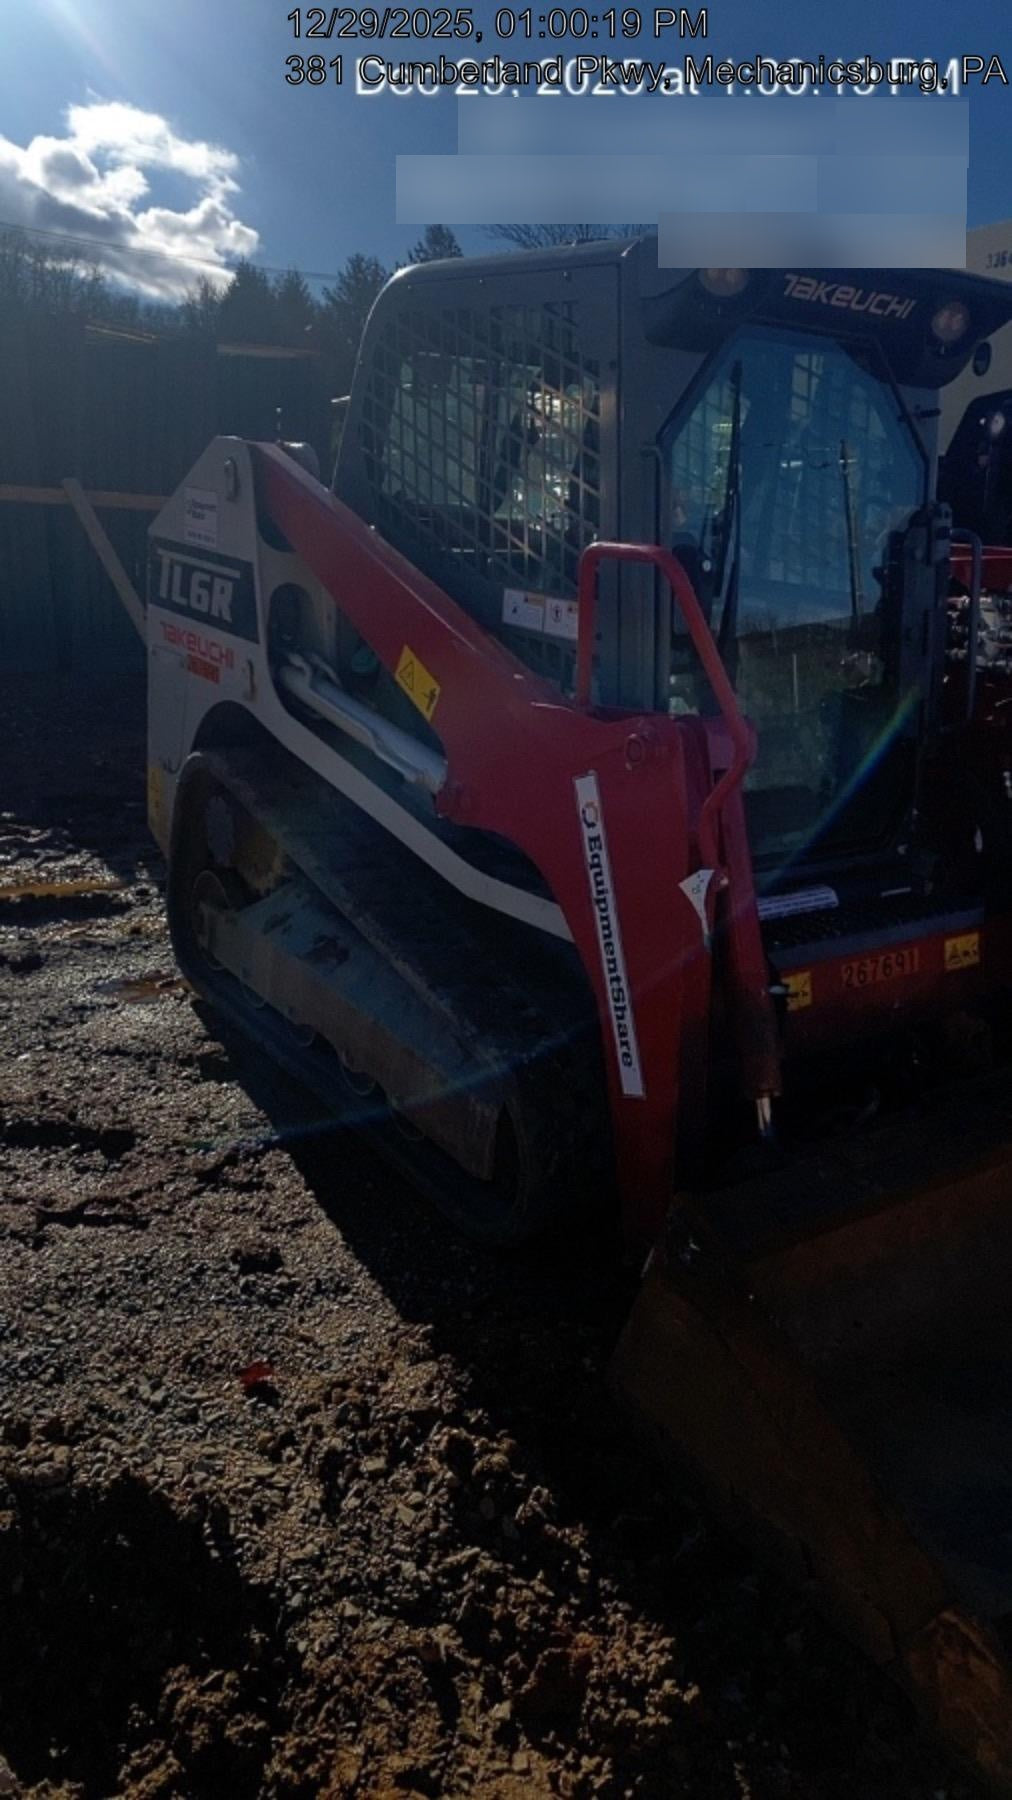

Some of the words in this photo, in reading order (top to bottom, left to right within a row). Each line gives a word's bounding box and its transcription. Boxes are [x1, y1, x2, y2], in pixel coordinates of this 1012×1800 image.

[783, 272, 917, 320] TAKEUCHI
[156, 547, 241, 624] TL6R
[586, 835, 634, 1068] EquipmentShare
[841, 946, 920, 988] 267691
